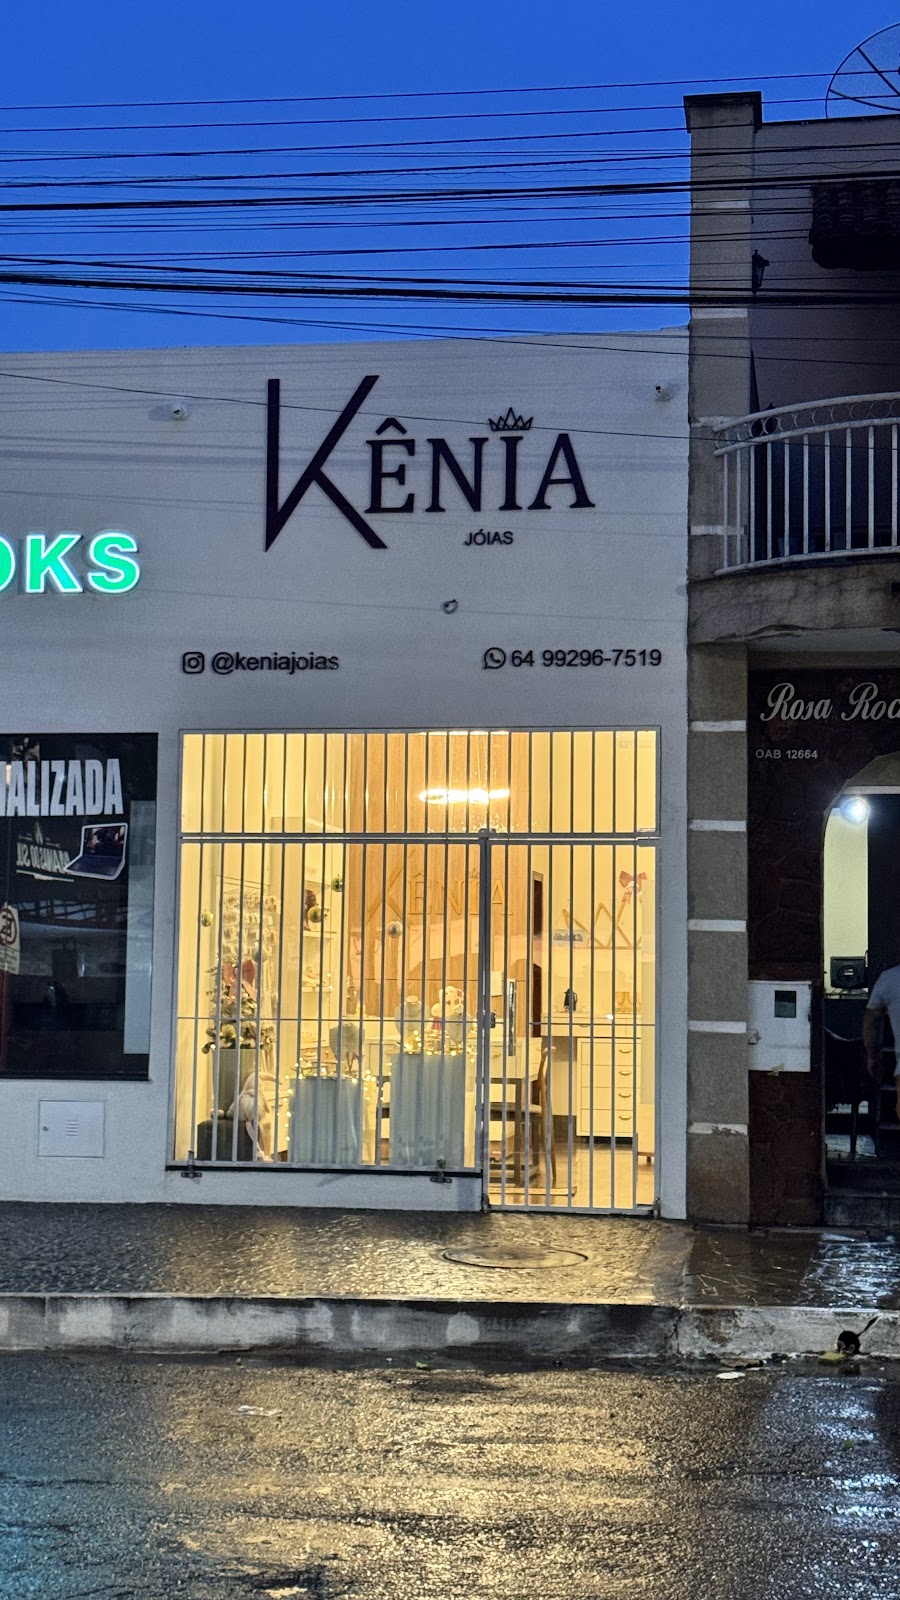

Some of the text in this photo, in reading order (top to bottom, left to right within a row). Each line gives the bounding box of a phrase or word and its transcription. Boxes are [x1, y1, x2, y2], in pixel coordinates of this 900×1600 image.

[265, 375, 596, 552] KÊNIA
[464, 529, 514, 546] JÓIAS
[0, 532, 140, 593] KS
[211, 651, 339, 675] @keniajoias
[511, 649, 662, 667] 64 99296-7519
[760, 682, 833, 721] Rosa
[755, 749, 818, 759] OAB 12664
